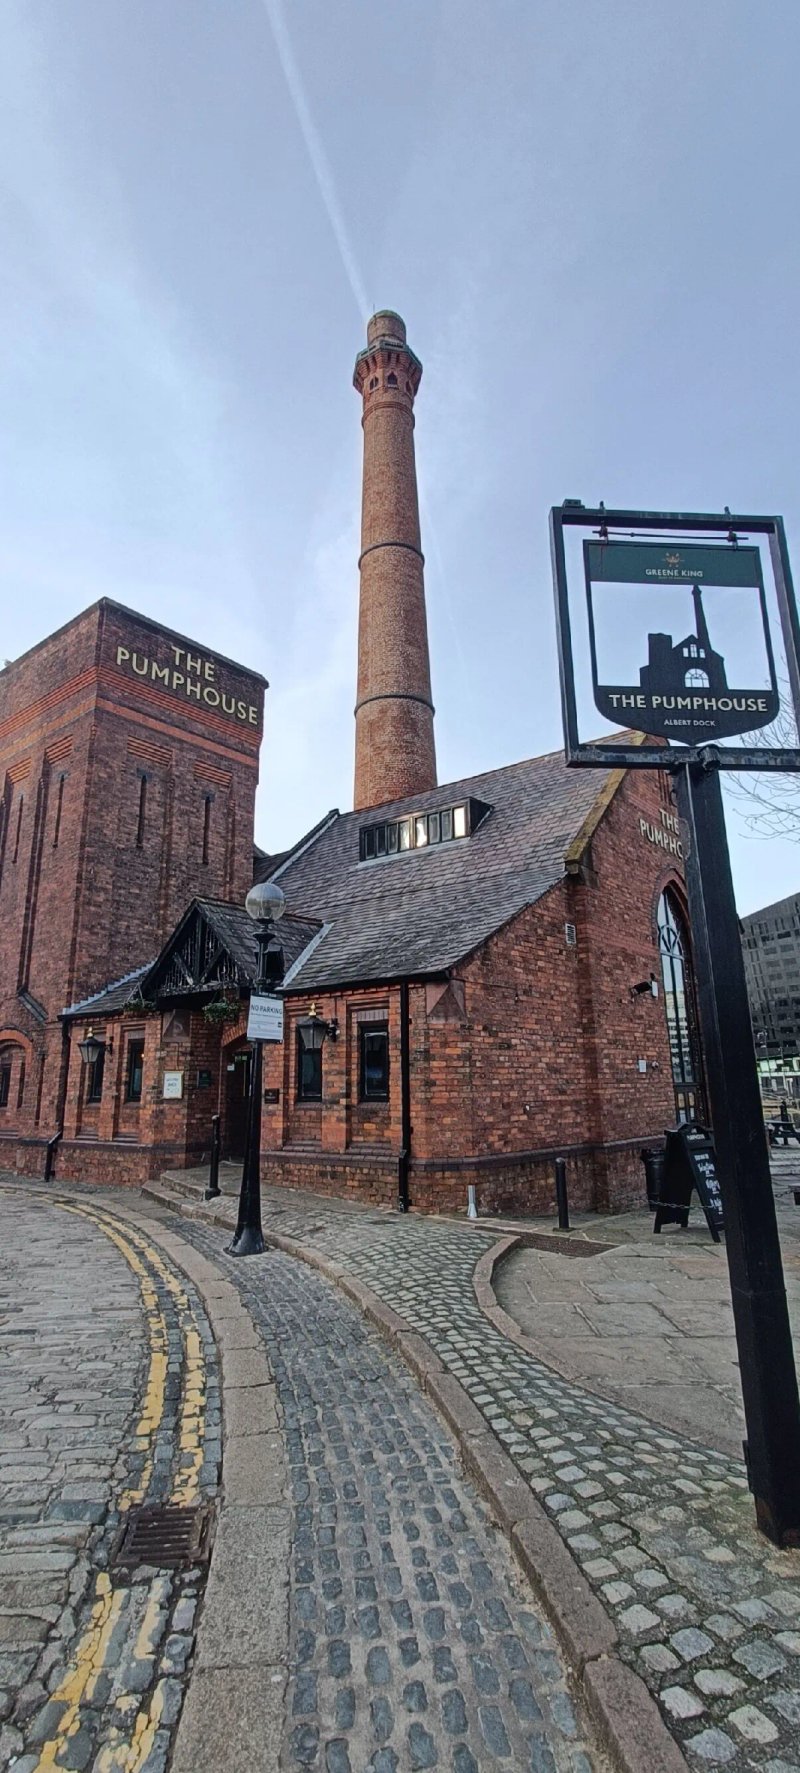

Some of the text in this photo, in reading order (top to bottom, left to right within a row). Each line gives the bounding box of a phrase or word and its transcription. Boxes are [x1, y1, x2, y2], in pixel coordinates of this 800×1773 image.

[645, 568, 704, 578] GREENE KING
[171, 646, 215, 681] THE
[116, 646, 258, 725] PUMPHOUSE
[609, 694, 768, 712] THE PUMPHOUSE
[663, 719, 691, 727] ALBERT
[659, 808, 680, 836] THE
[640, 818, 684, 859] PUMPHO
[251, 1004, 282, 1015] NO PARKING
